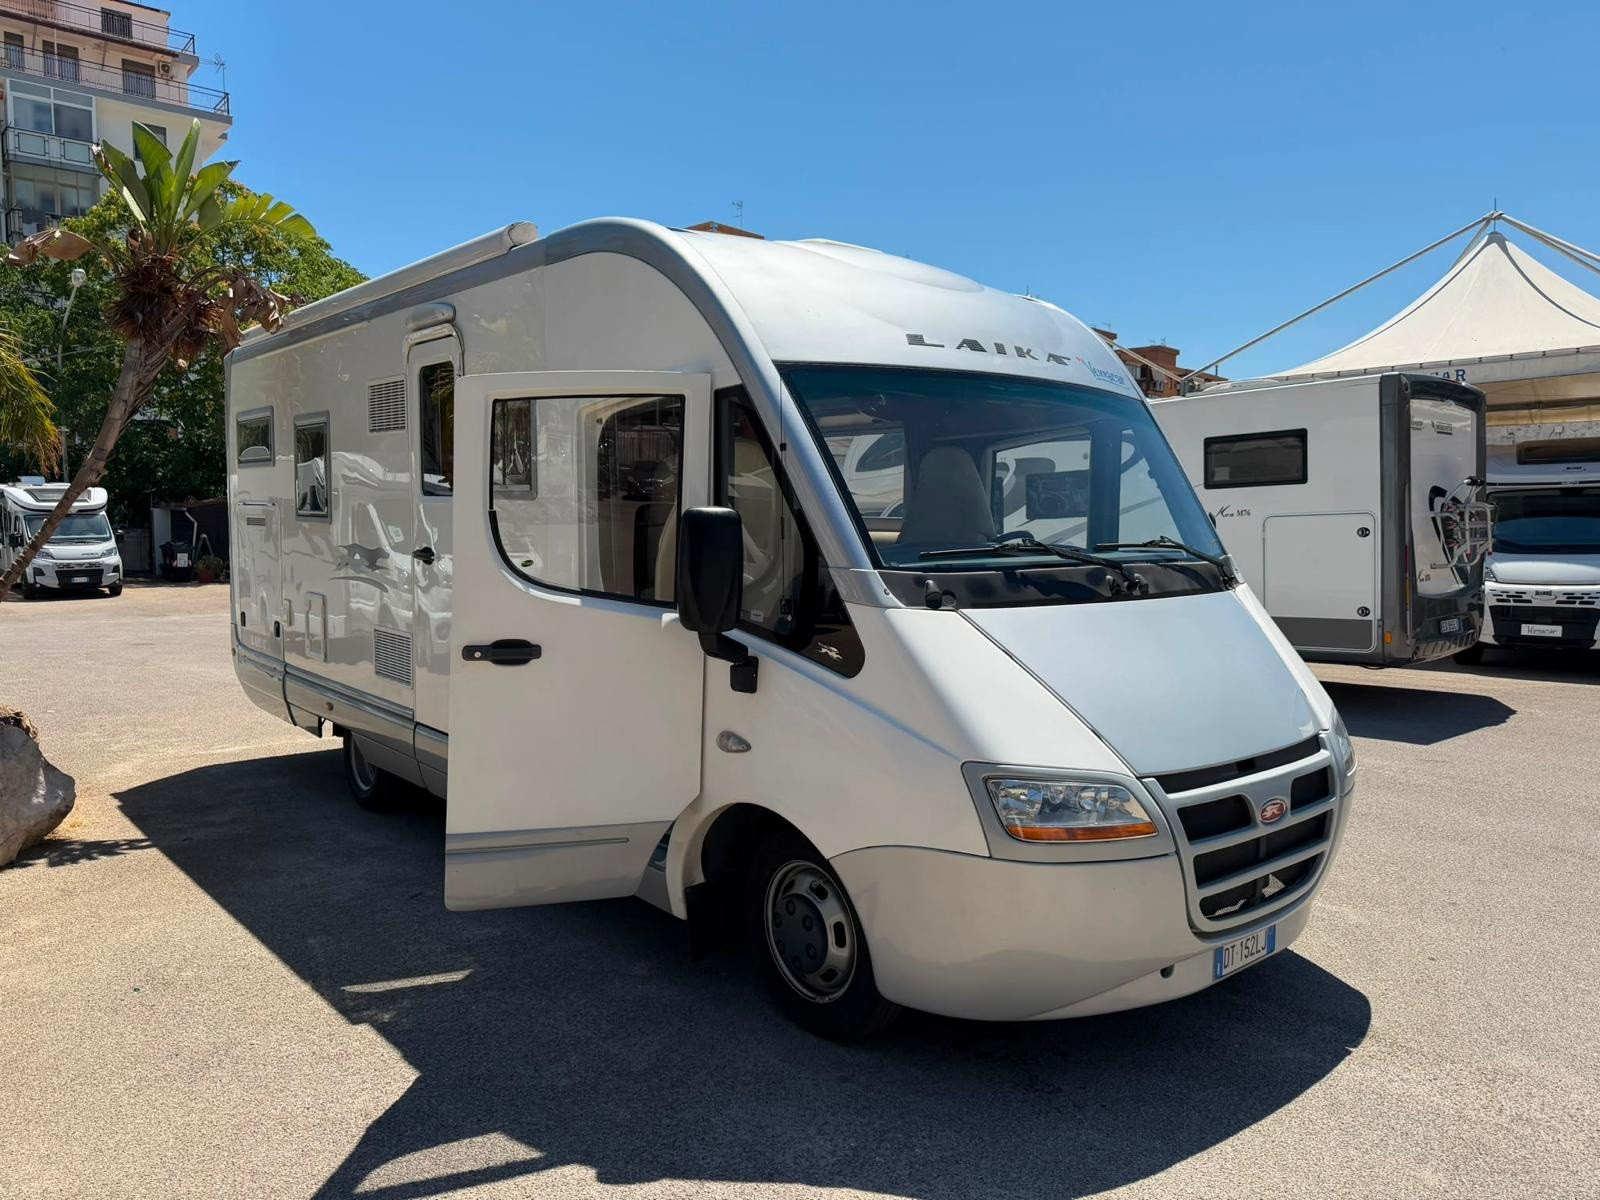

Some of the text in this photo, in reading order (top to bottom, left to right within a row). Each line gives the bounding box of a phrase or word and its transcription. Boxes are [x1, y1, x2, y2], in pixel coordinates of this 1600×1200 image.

[906, 333, 1071, 366] LAIKA
[1430, 369, 1466, 381] AR
[1223, 944, 1236, 970] DT
[1240, 930, 1267, 961] 152LJ
